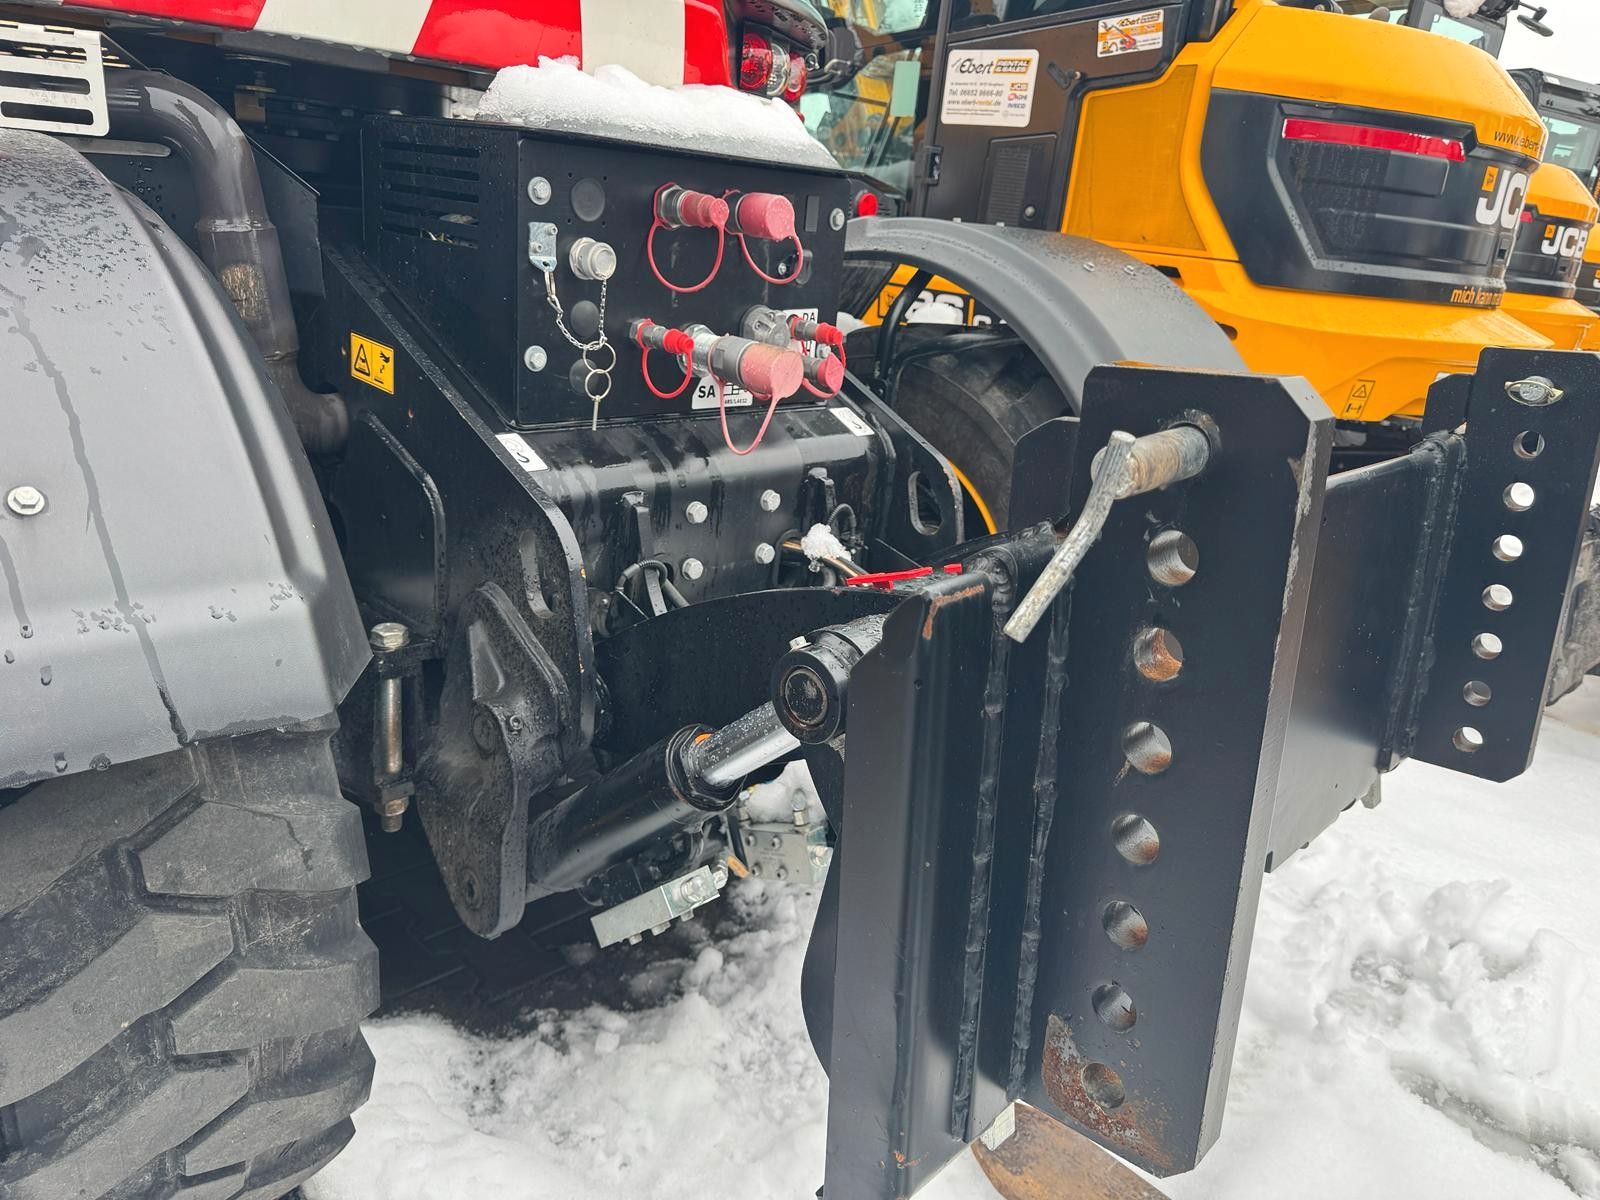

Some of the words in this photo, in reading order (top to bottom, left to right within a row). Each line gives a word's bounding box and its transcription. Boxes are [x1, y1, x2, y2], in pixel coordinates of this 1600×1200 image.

[959, 58, 994, 74] Ebert
[1475, 169, 1528, 229] JC
[1541, 225, 1588, 259] JCB
[1450, 286, 1475, 304] mich
[698, 385, 716, 398] SA
